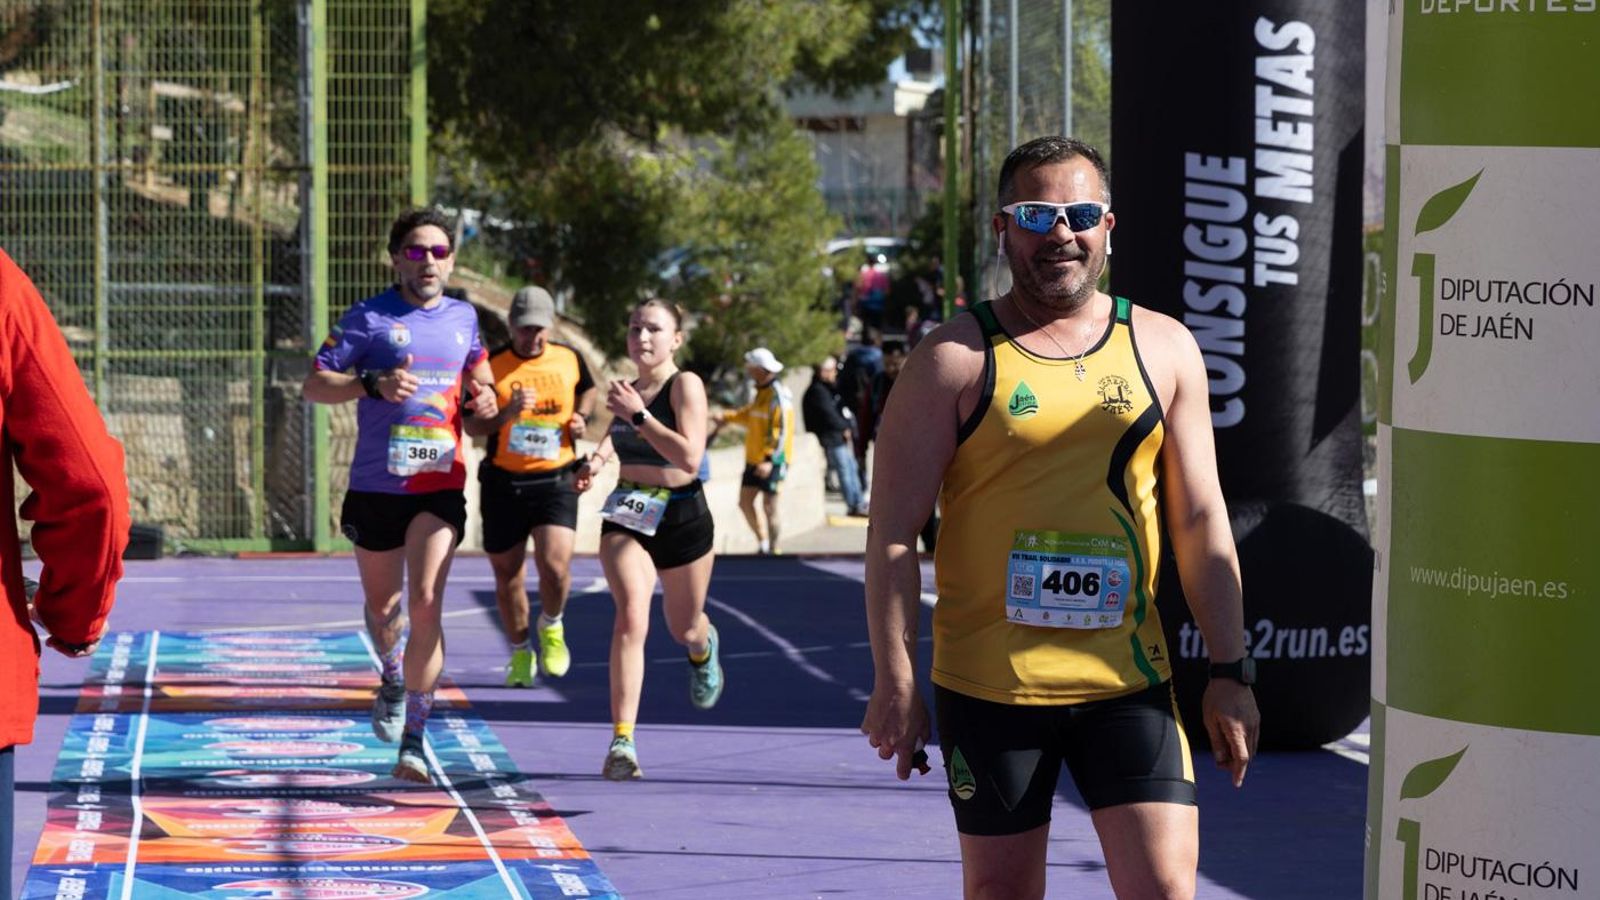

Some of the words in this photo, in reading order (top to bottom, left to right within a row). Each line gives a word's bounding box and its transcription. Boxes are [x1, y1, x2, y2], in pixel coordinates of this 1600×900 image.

[1254, 16, 1316, 203] METAS
[1253, 212, 1300, 287] TUS
[1183, 152, 1248, 428] CONSIGUE
[1441, 278, 1594, 306] DIPUTACIÓN
[1440, 313, 1467, 336] DE
[1471, 312, 1533, 340] JAÉN
[408, 447, 438, 460] 388
[1042, 570, 1100, 596] 406
[1410, 566, 1568, 599] www.dipujaen.es
[1425, 848, 1578, 891] DIPUTACIÓN
